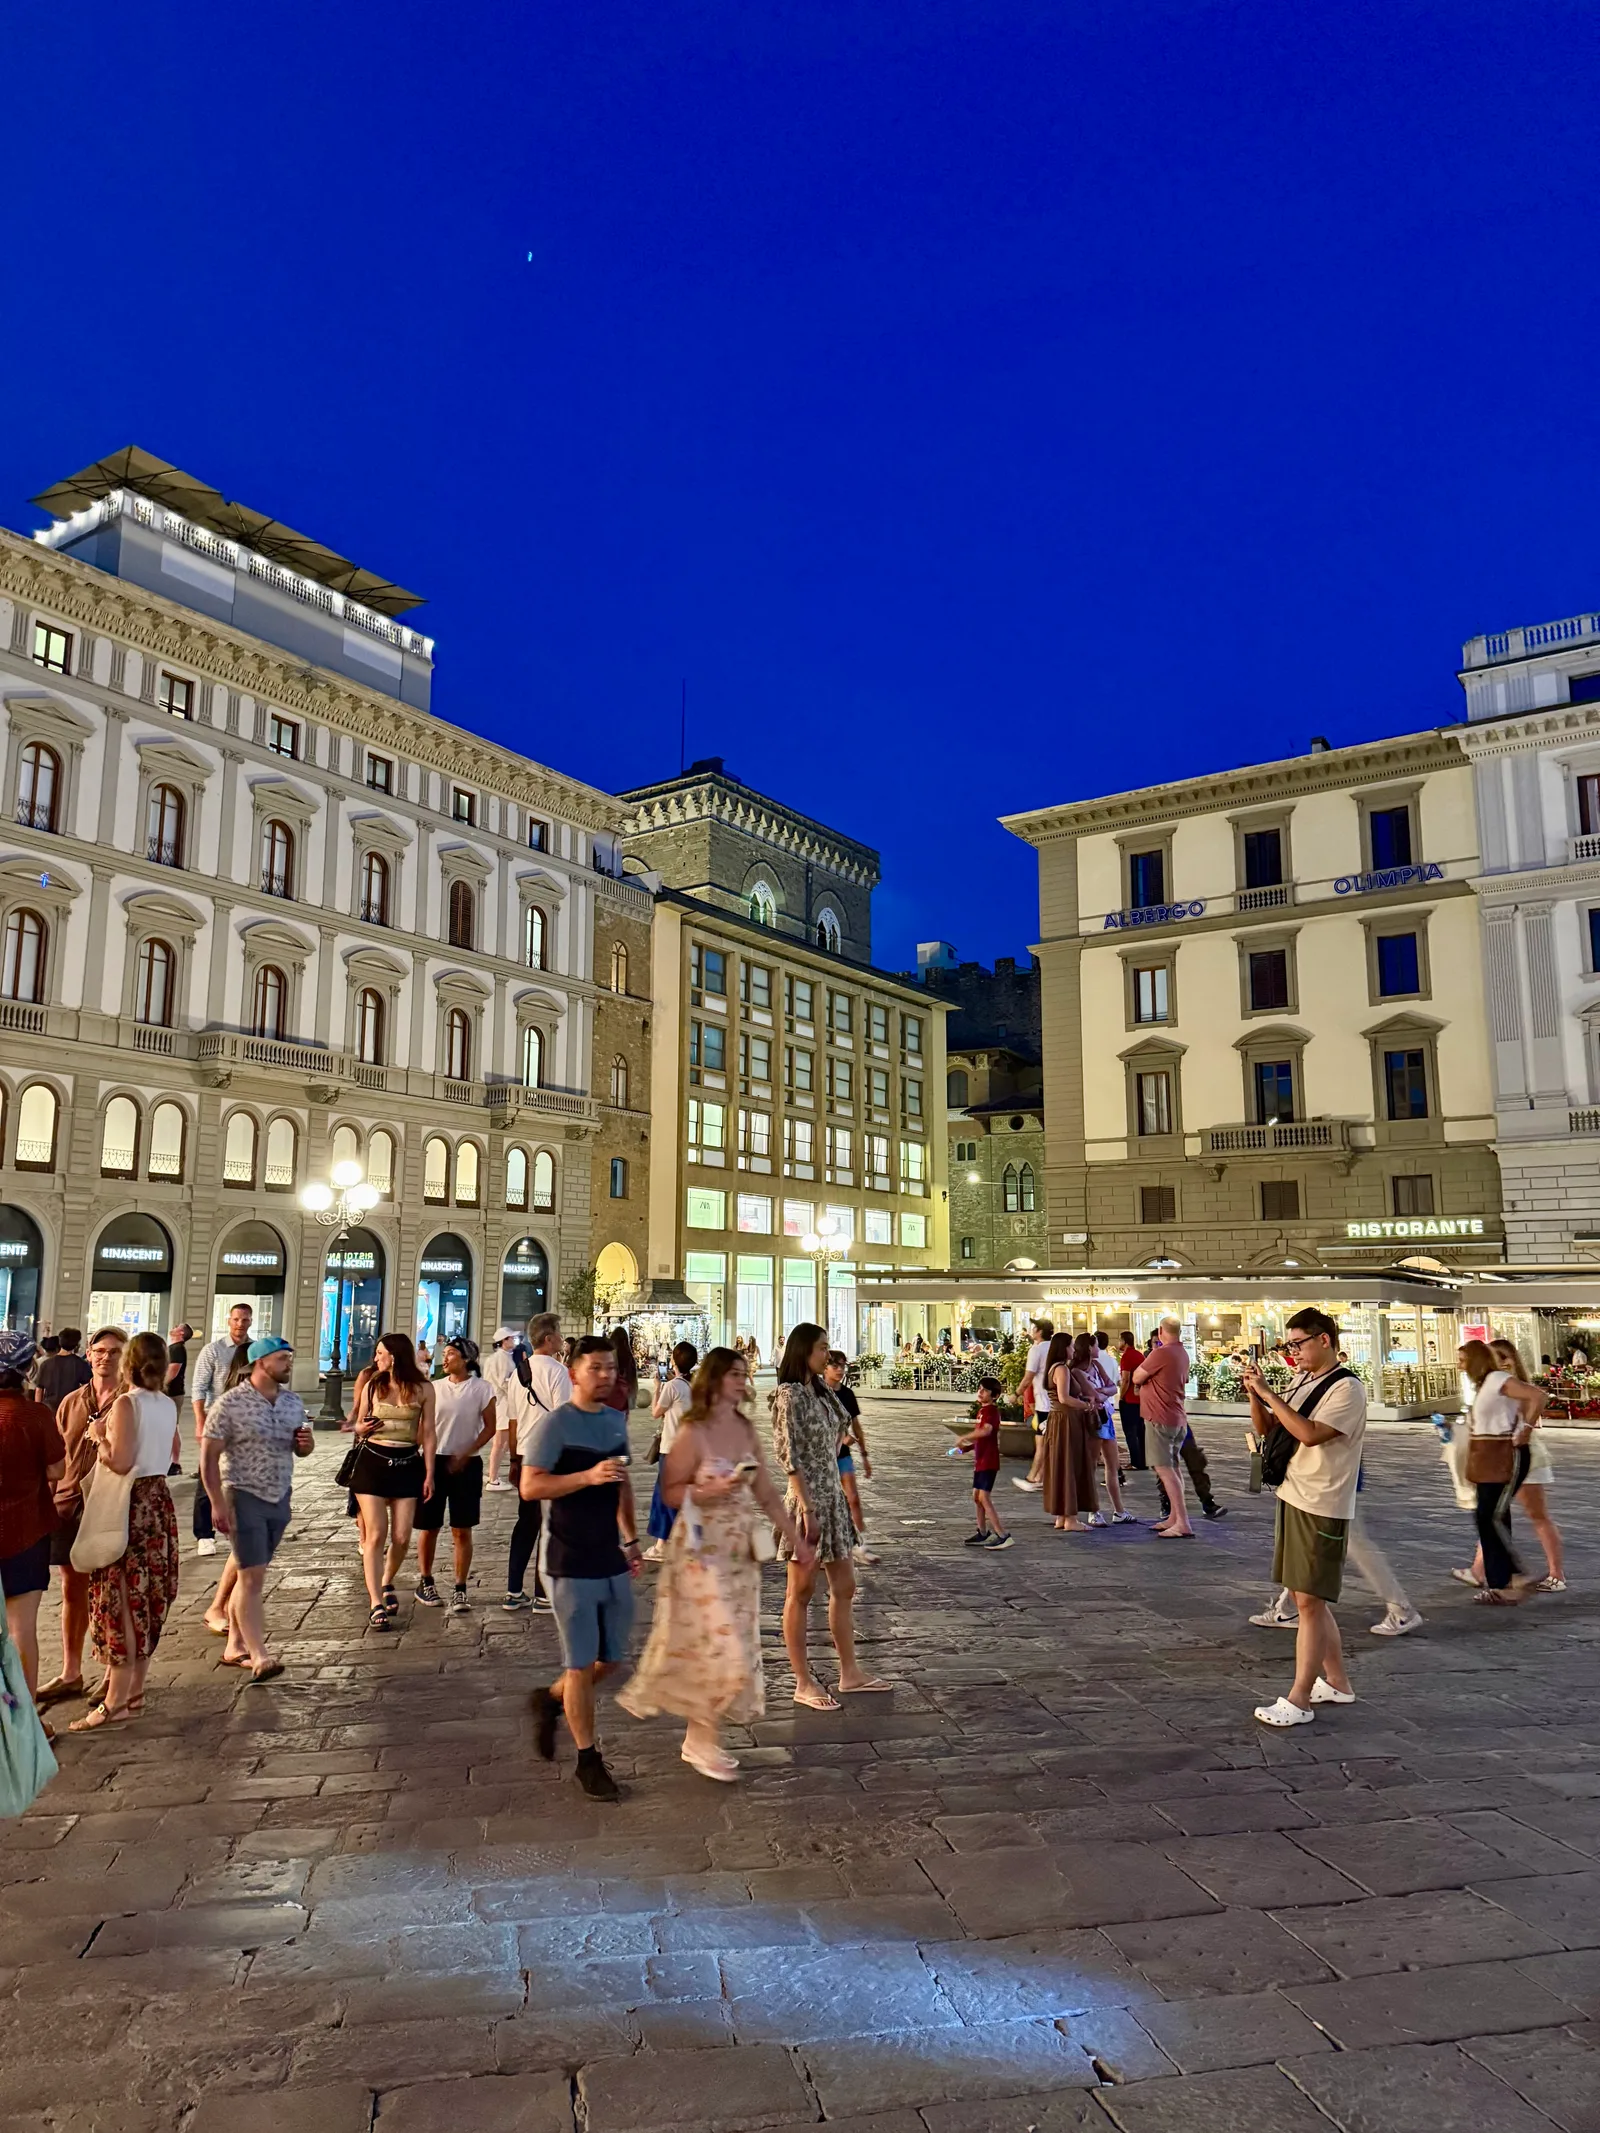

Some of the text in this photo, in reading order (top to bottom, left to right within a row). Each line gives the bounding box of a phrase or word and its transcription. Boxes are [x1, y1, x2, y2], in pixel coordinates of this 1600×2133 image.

[1103, 863, 1444, 930] ALBERGO OLIMPIA
[1346, 1219, 1484, 1237] RISTORANTE
[101, 1247, 163, 1261] RINASCENTE
[223, 1252, 278, 1266] RINASCENTE
[420, 1260, 463, 1272] RINASCENTE
[1049, 1286, 1131, 1297] FIORINO D'ORO
